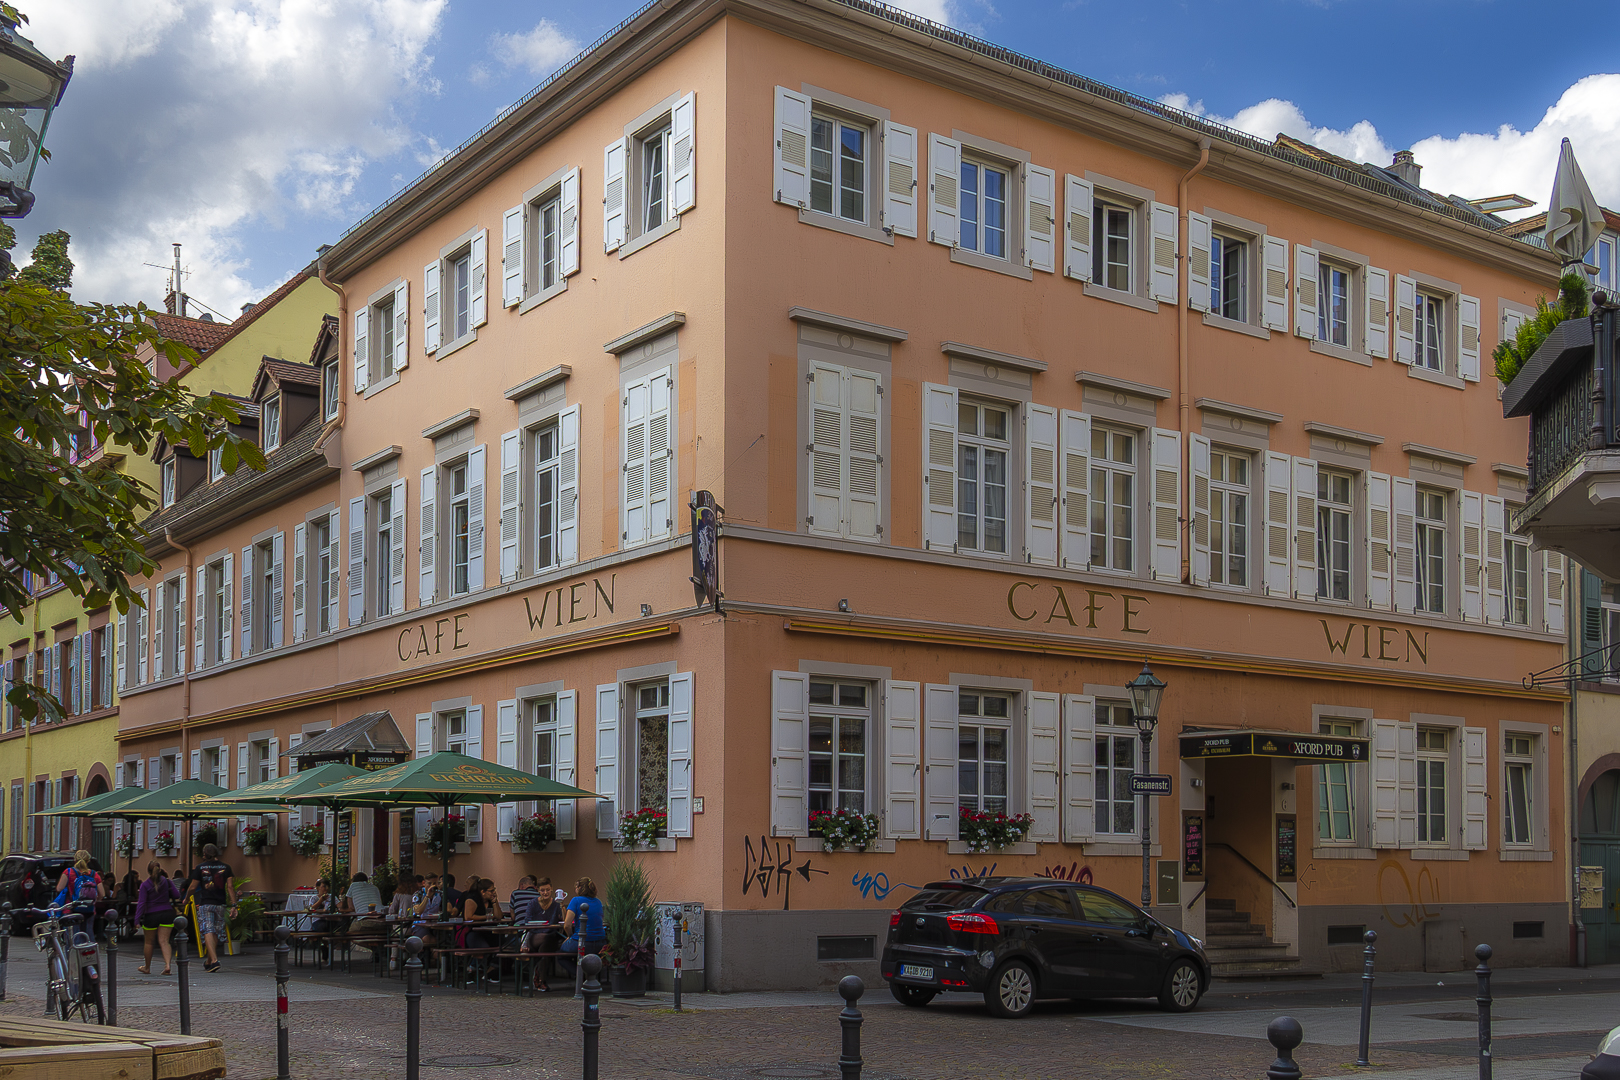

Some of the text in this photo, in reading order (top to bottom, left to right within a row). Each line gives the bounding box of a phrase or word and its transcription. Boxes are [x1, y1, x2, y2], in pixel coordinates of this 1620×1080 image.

[397, 573, 617, 662] CAFE WIEN
[1007, 581, 1430, 665] CAFE WIEN
[1288, 742, 1343, 756] OXFORD PUB
[428, 773, 535, 785] EICHBAUM
[1132, 778, 1169, 790] Fasanenstr.
[919, 967, 932, 978] 9210
